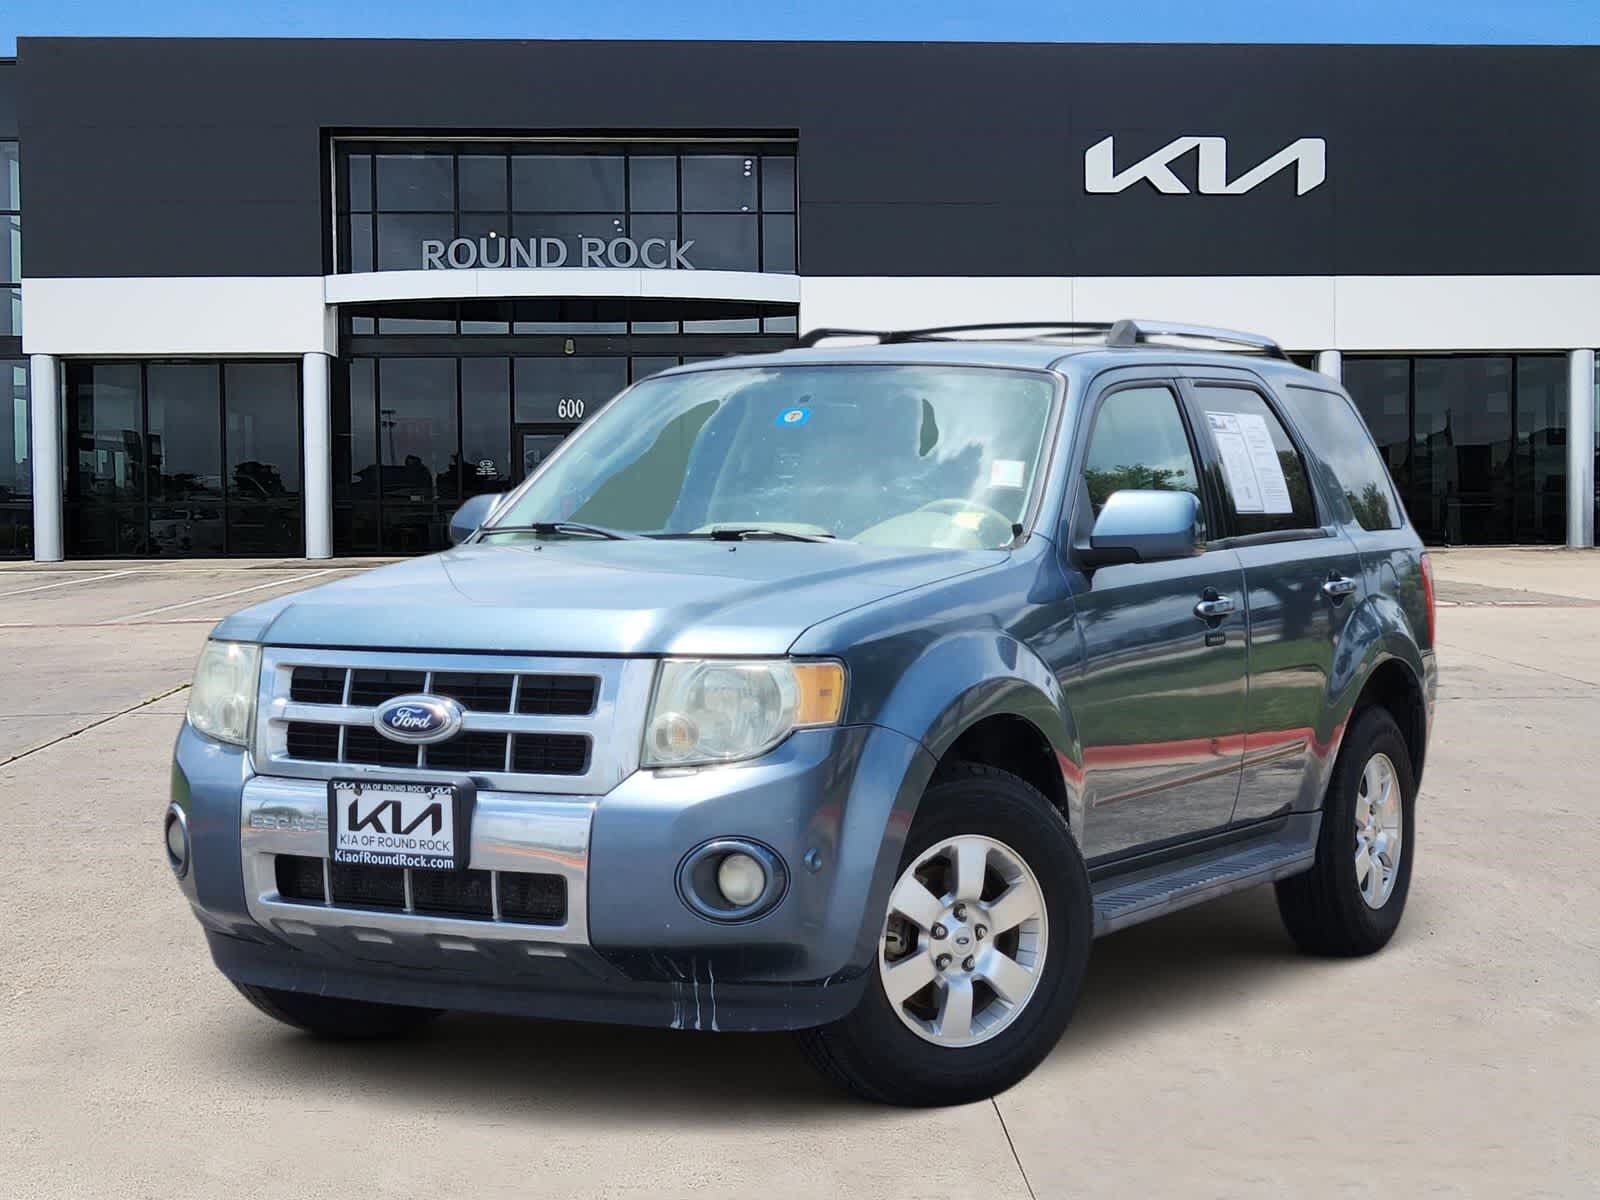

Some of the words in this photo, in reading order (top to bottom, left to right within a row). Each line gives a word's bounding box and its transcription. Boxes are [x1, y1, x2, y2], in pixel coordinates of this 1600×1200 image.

[1085, 135, 1326, 196] KIA
[422, 237, 568, 270] ROUND
[582, 237, 697, 270] ROCK
[558, 399, 585, 418] 600
[391, 706, 432, 729] Ford
[348, 798, 442, 836] KIA
[340, 834, 358, 846] KIA
[361, 836, 375, 847] OF
[377, 837, 416, 850] ROUND
[420, 840, 450, 852] ROCK
[335, 849, 454, 869] KiaofRoundRock.com
